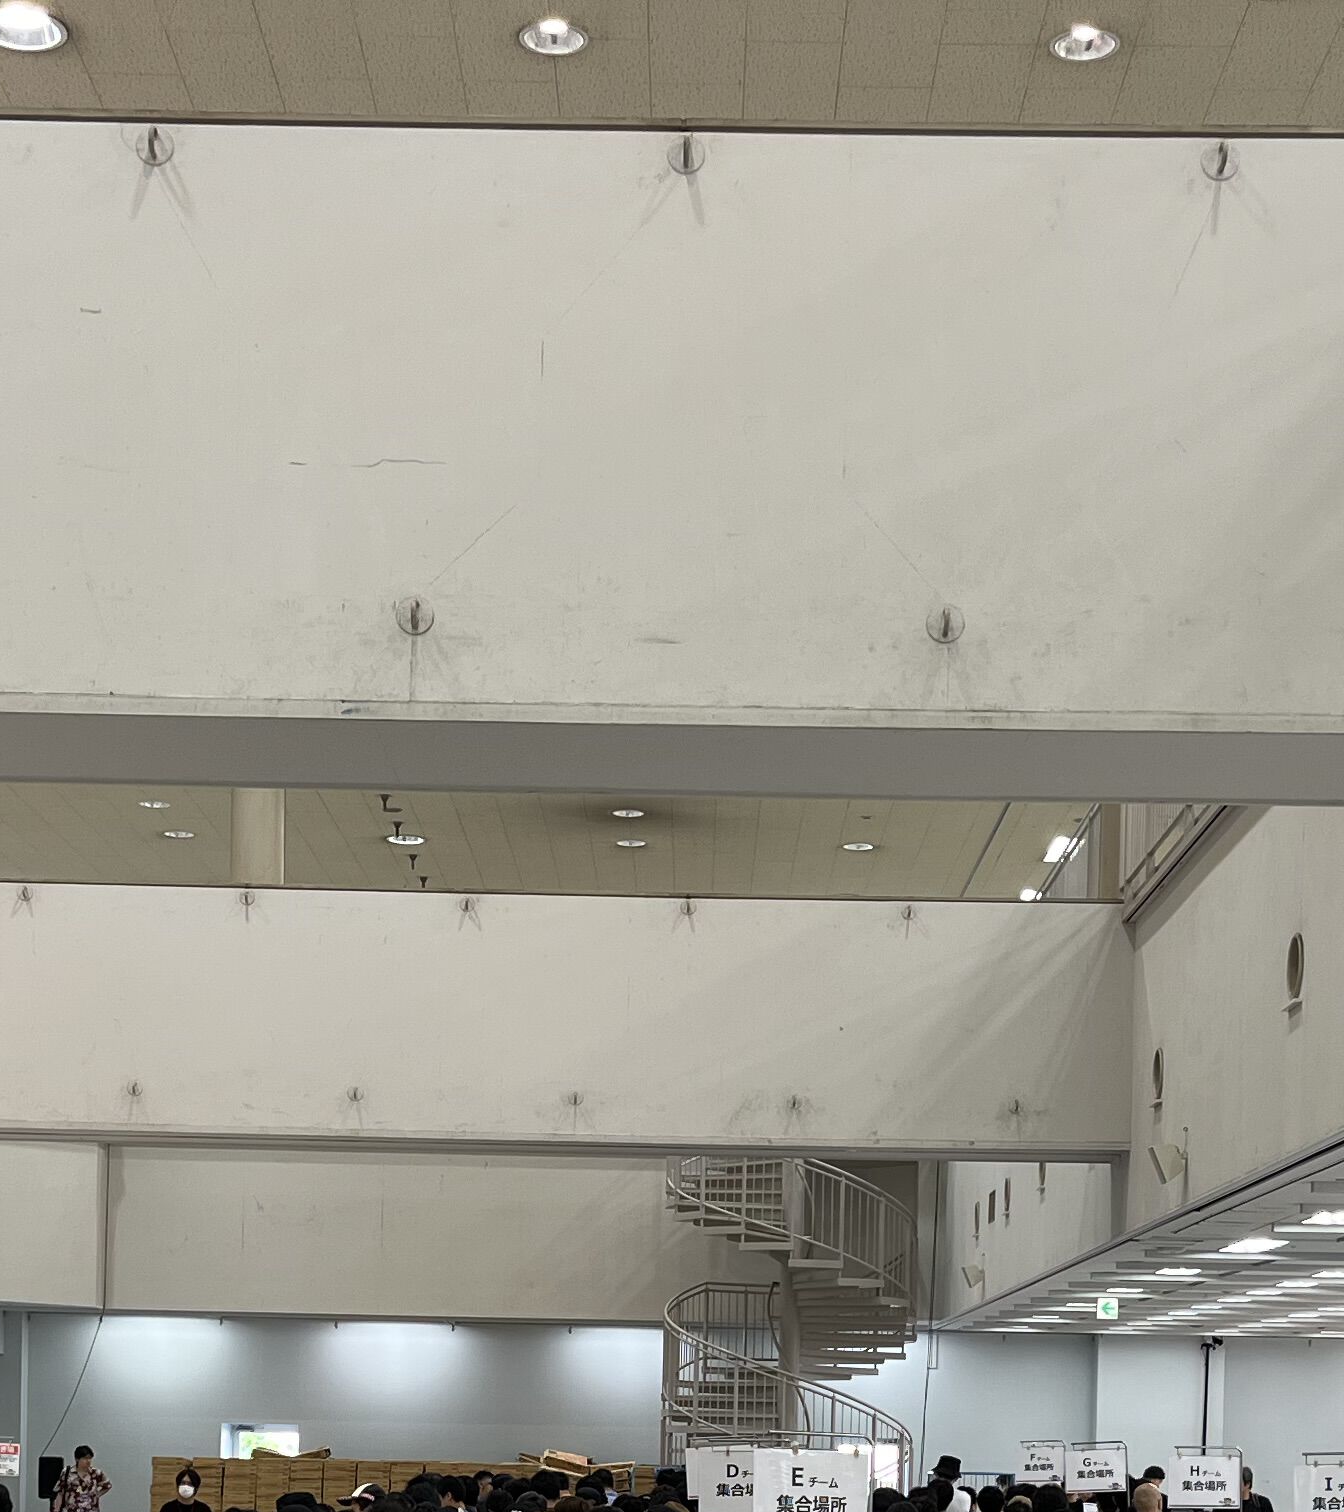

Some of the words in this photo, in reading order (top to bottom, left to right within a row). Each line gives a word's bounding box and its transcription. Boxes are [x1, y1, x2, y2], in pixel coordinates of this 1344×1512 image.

[1083, 1458, 1091, 1467] G
[726, 1464, 739, 1478] D
[741, 1470, 754, 1478] チー
[1190, 1465, 1200, 1477] H
[792, 1467, 804, 1487] E
[808, 1476, 839, 1489] チーム
[1324, 1477, 1333, 1491] I
[1182, 1480, 1227, 1492] 集合場所
